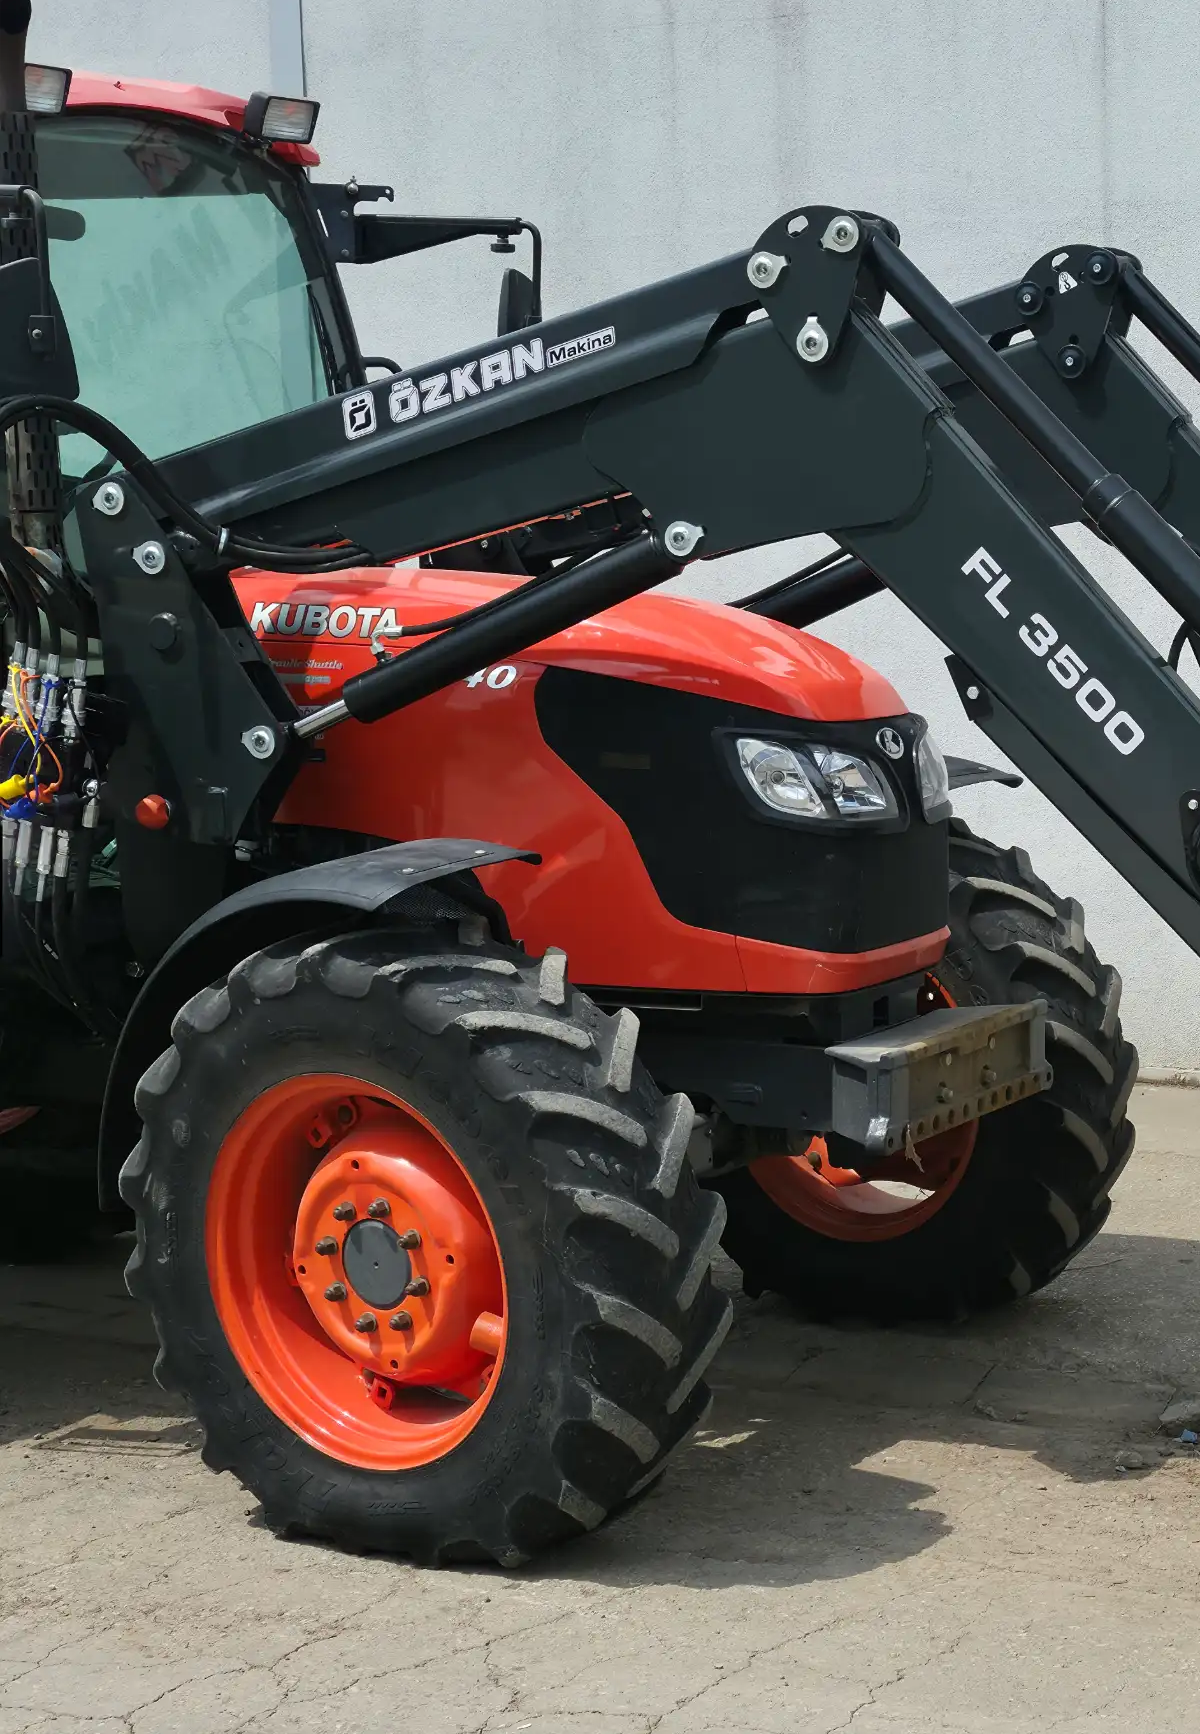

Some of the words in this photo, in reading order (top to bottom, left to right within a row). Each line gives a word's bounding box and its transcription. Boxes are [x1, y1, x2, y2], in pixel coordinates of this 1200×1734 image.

[389, 337, 545, 423] ÖZKAN
[549, 332, 613, 364] Makina
[250, 601, 398, 638] KUBOTA
[960, 546, 1012, 619] FL
[1018, 612, 1145, 756] 3500
